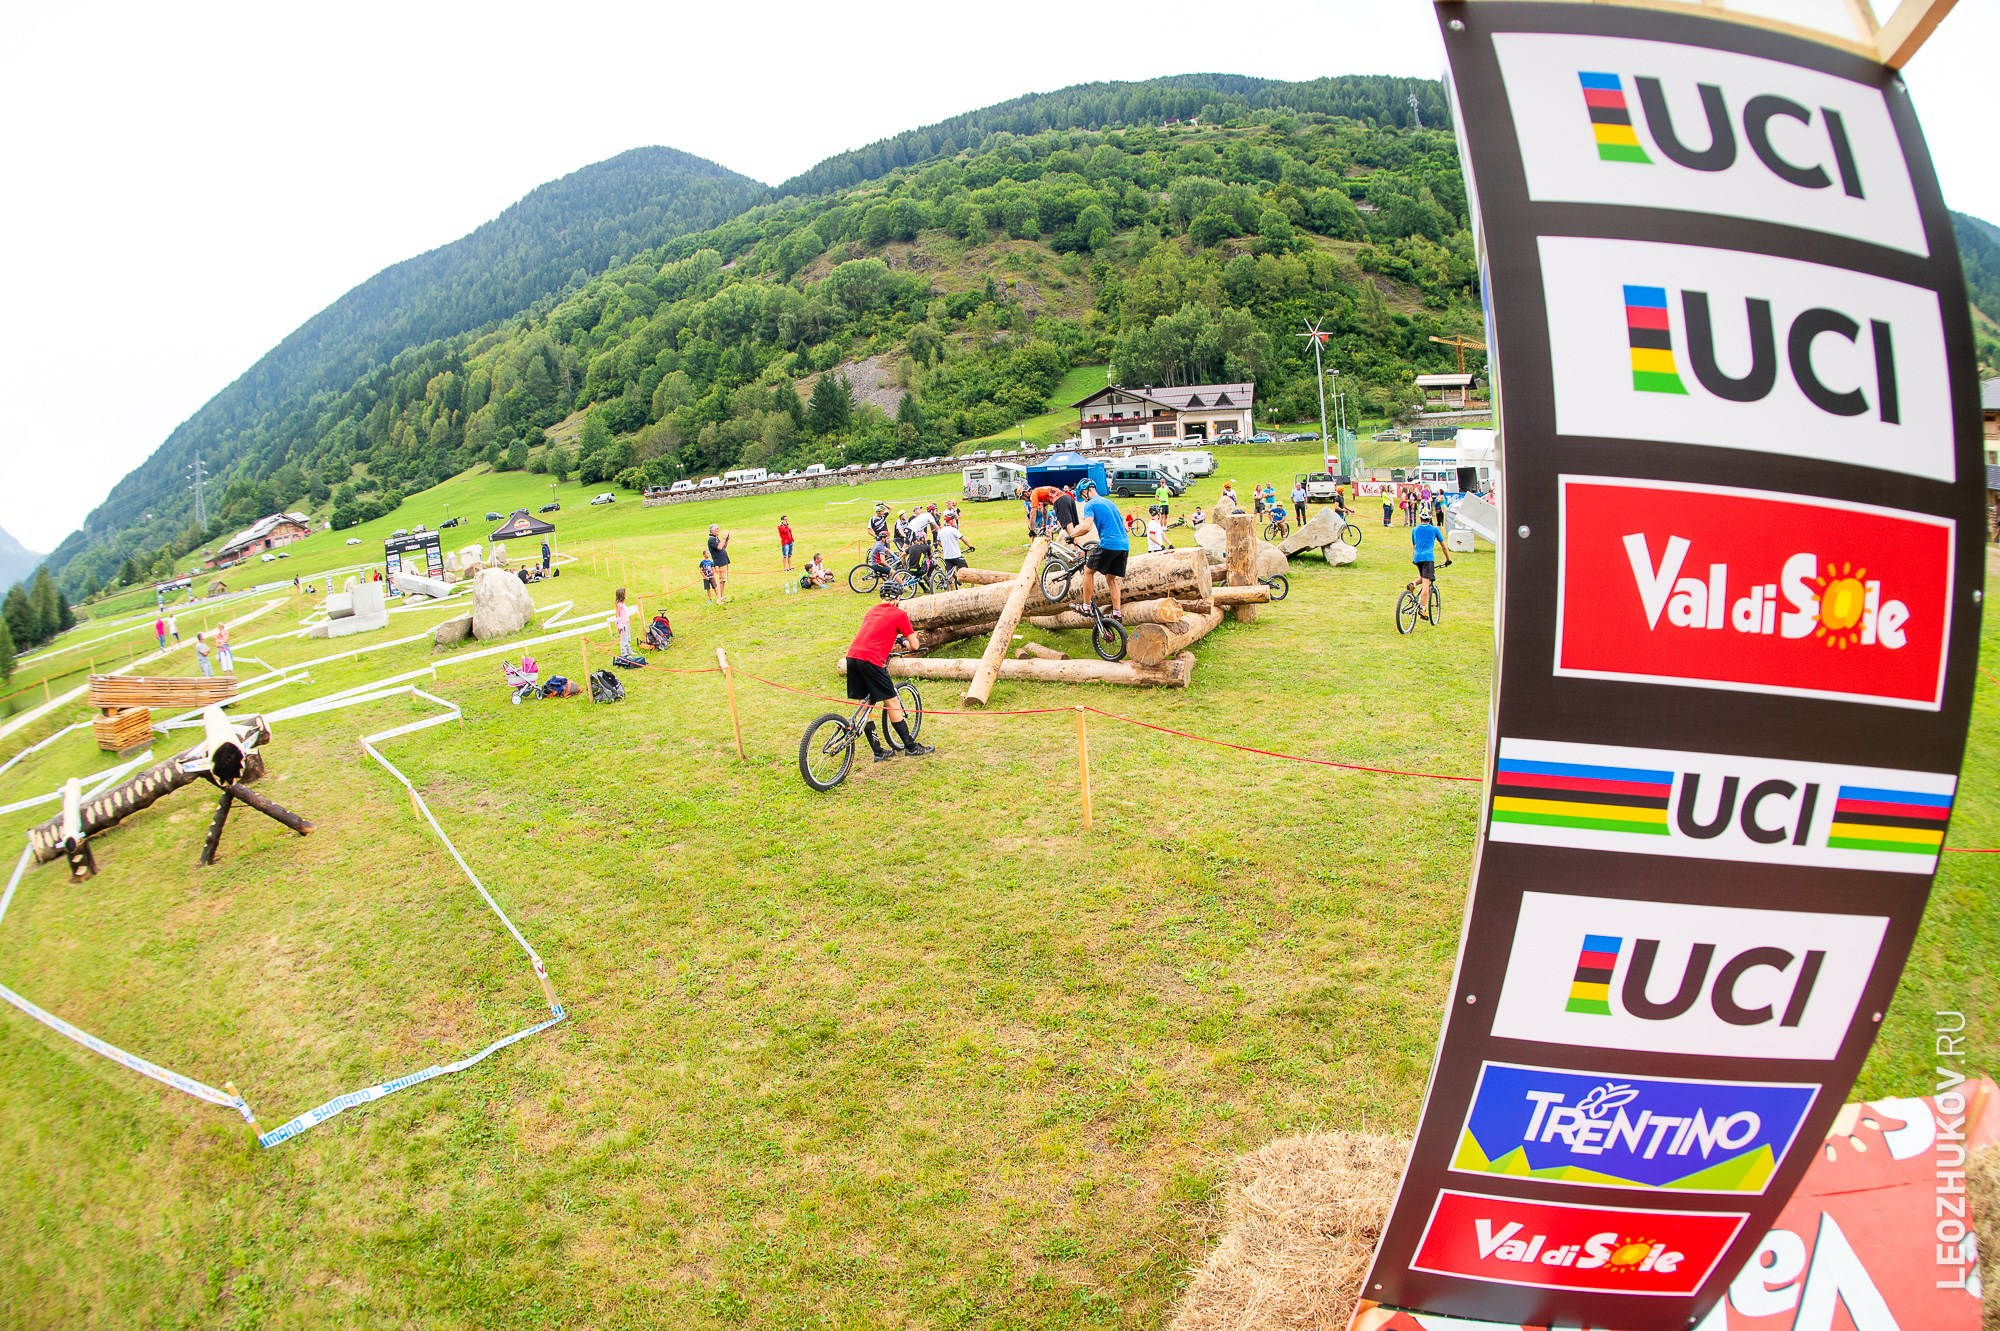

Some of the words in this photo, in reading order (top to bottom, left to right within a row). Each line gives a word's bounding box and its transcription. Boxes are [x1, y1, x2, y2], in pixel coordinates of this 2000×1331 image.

[1634, 75, 1866, 200] UCI
[1680, 289, 1902, 426] UCI
[1622, 532, 1728, 631] Val
[1731, 584, 1778, 635] di
[1780, 552, 1911, 650] Sole
[1677, 772, 1820, 846] UCI
[1621, 938, 1827, 1028] UCI
[312, 1090, 371, 1121] SHIMANO
[1523, 1090, 1761, 1160] TRENTINO
[1474, 1218, 1547, 1263] Val
[1541, 1245, 1581, 1267] di
[1575, 1232, 1685, 1274] Sole
